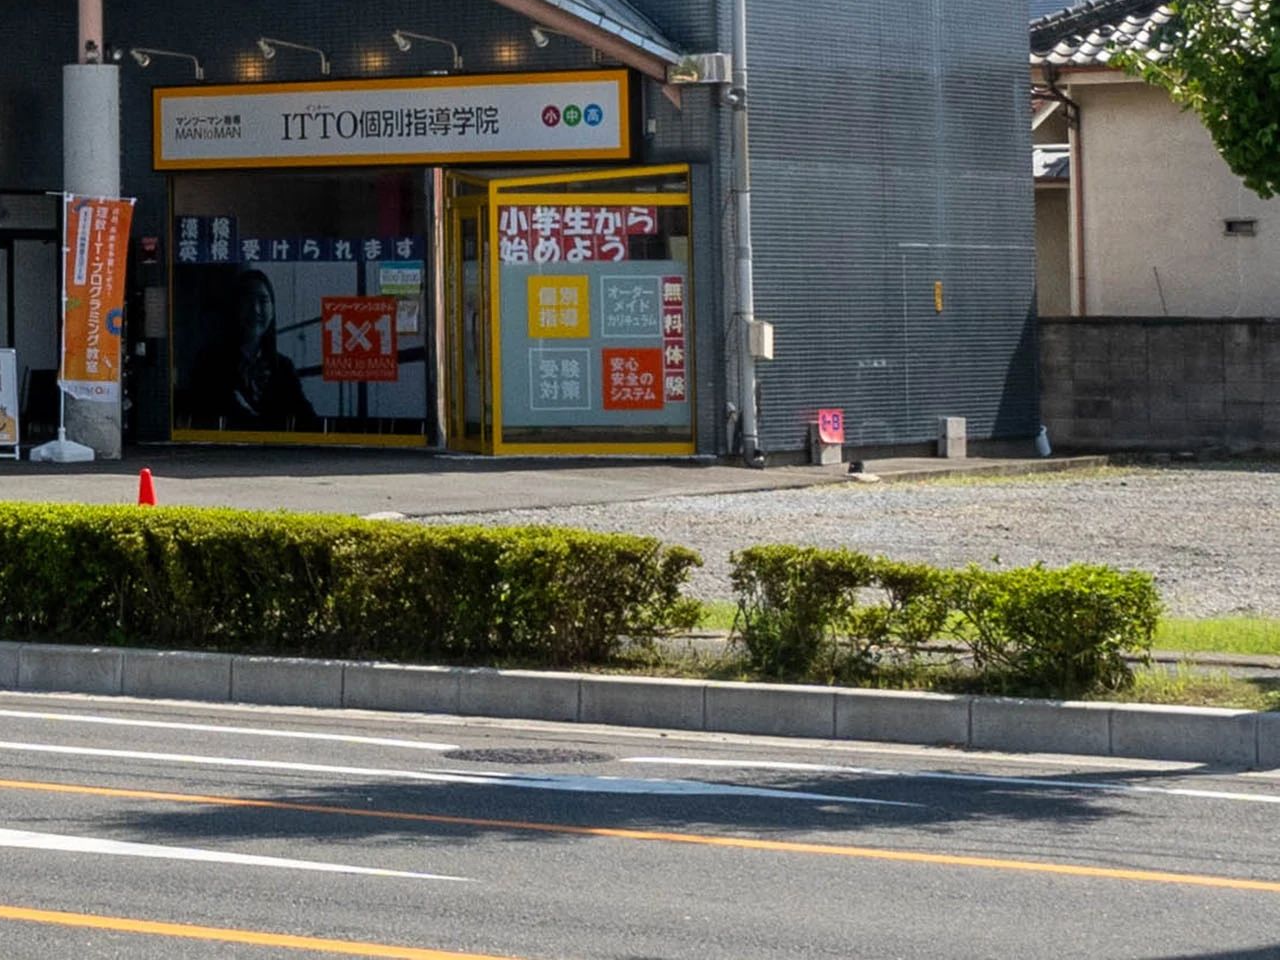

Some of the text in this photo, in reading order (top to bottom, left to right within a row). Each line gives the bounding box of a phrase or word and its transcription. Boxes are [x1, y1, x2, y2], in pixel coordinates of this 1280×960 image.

[500, 207, 654, 236] 小学生から
[500, 236, 626, 265] 始めよう
[664, 281, 686, 396] 無料体験
[540, 359, 580, 378] 受験
[610, 357, 639, 372] 安心
[611, 372, 653, 386] 安全の
[540, 380, 580, 400] 対策
[611, 386, 656, 401] システム
